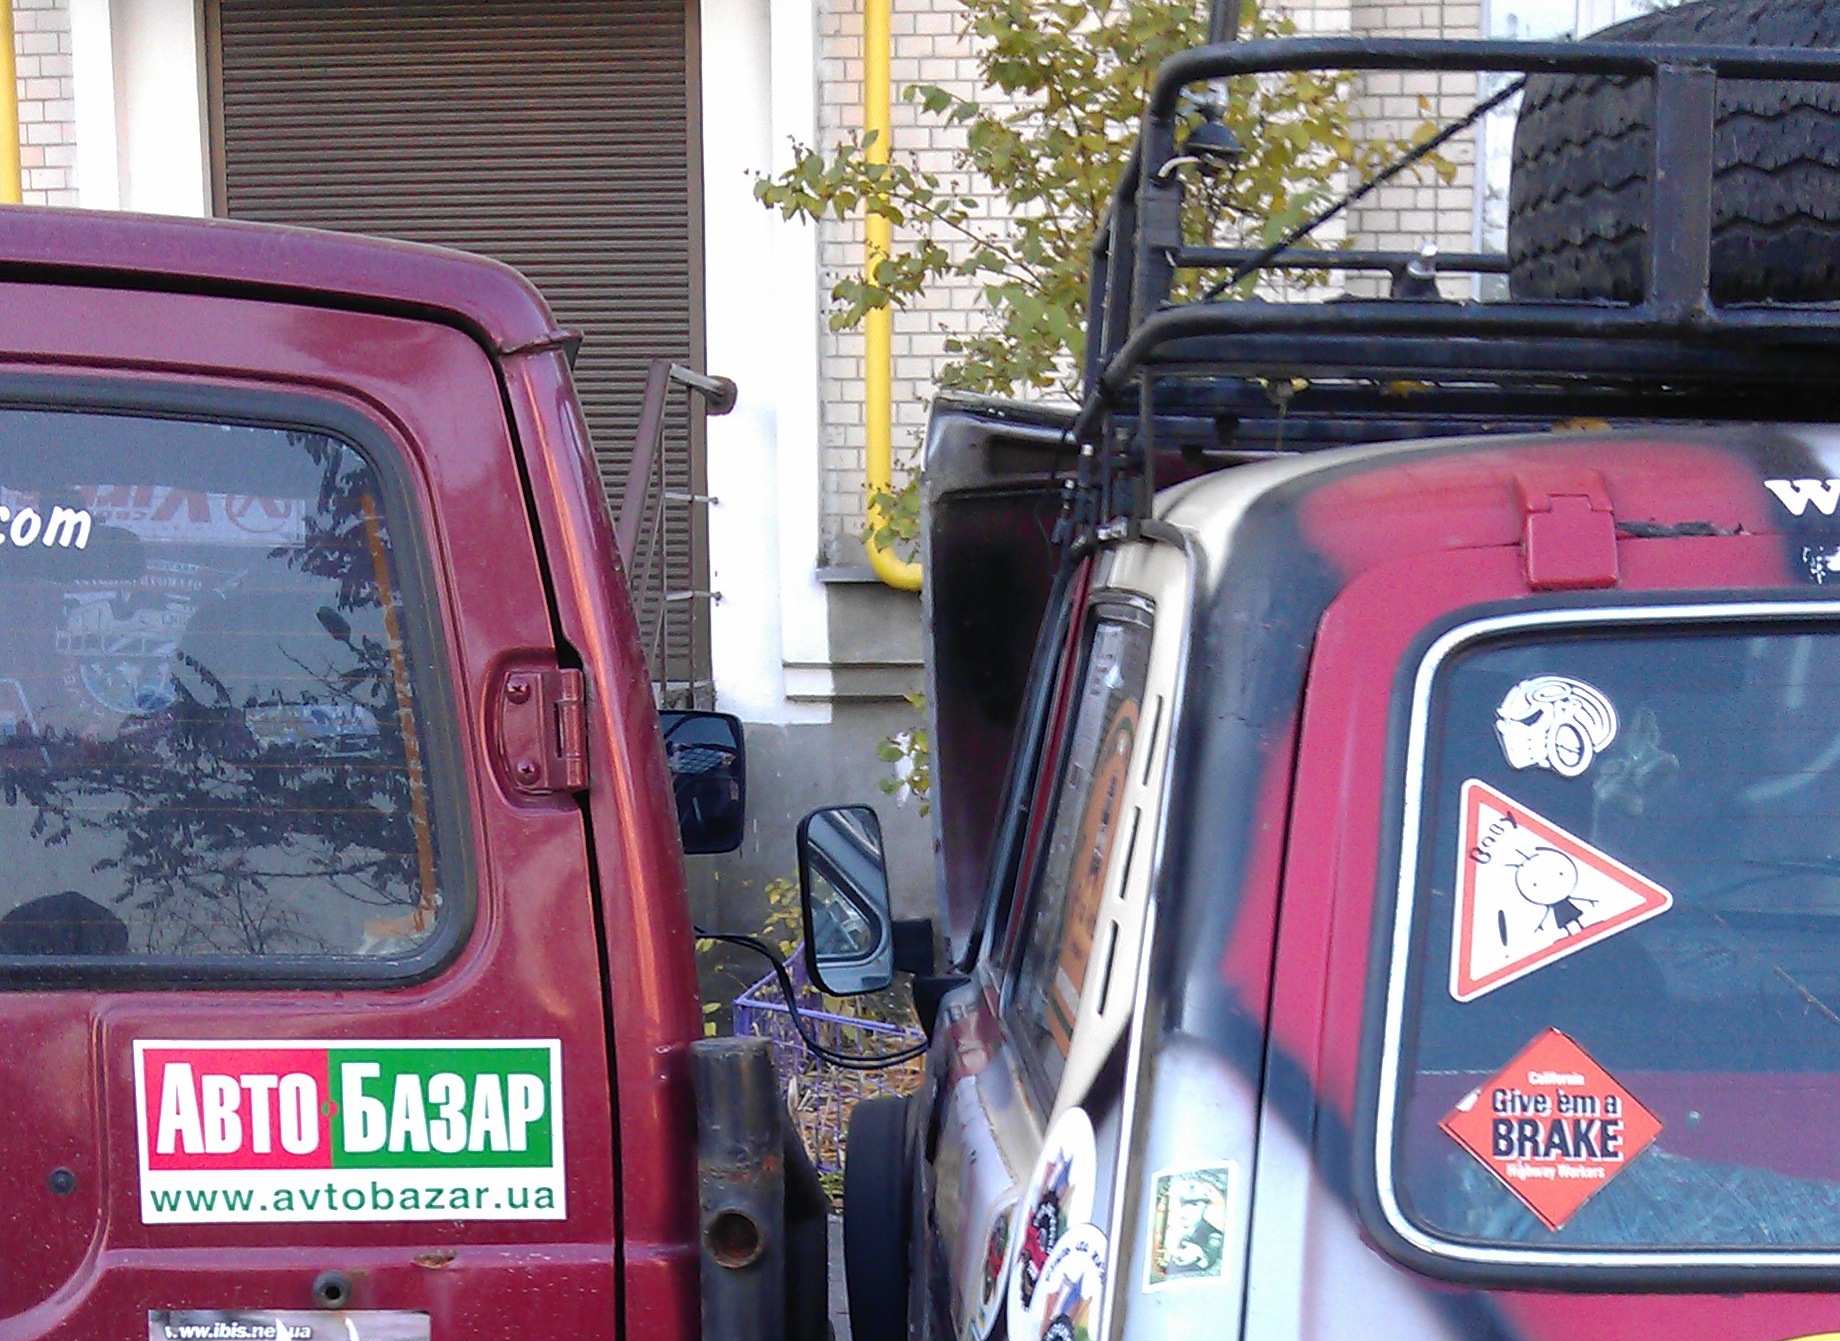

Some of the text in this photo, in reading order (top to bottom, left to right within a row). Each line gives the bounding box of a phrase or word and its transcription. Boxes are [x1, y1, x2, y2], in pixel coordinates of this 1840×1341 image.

[1492, 1088, 1551, 1117] Give
[1604, 1094, 1623, 1118] a
[1492, 1118, 1625, 1163] BRAKE
[150, 1181, 555, 1214] www.avtobazar.ua
